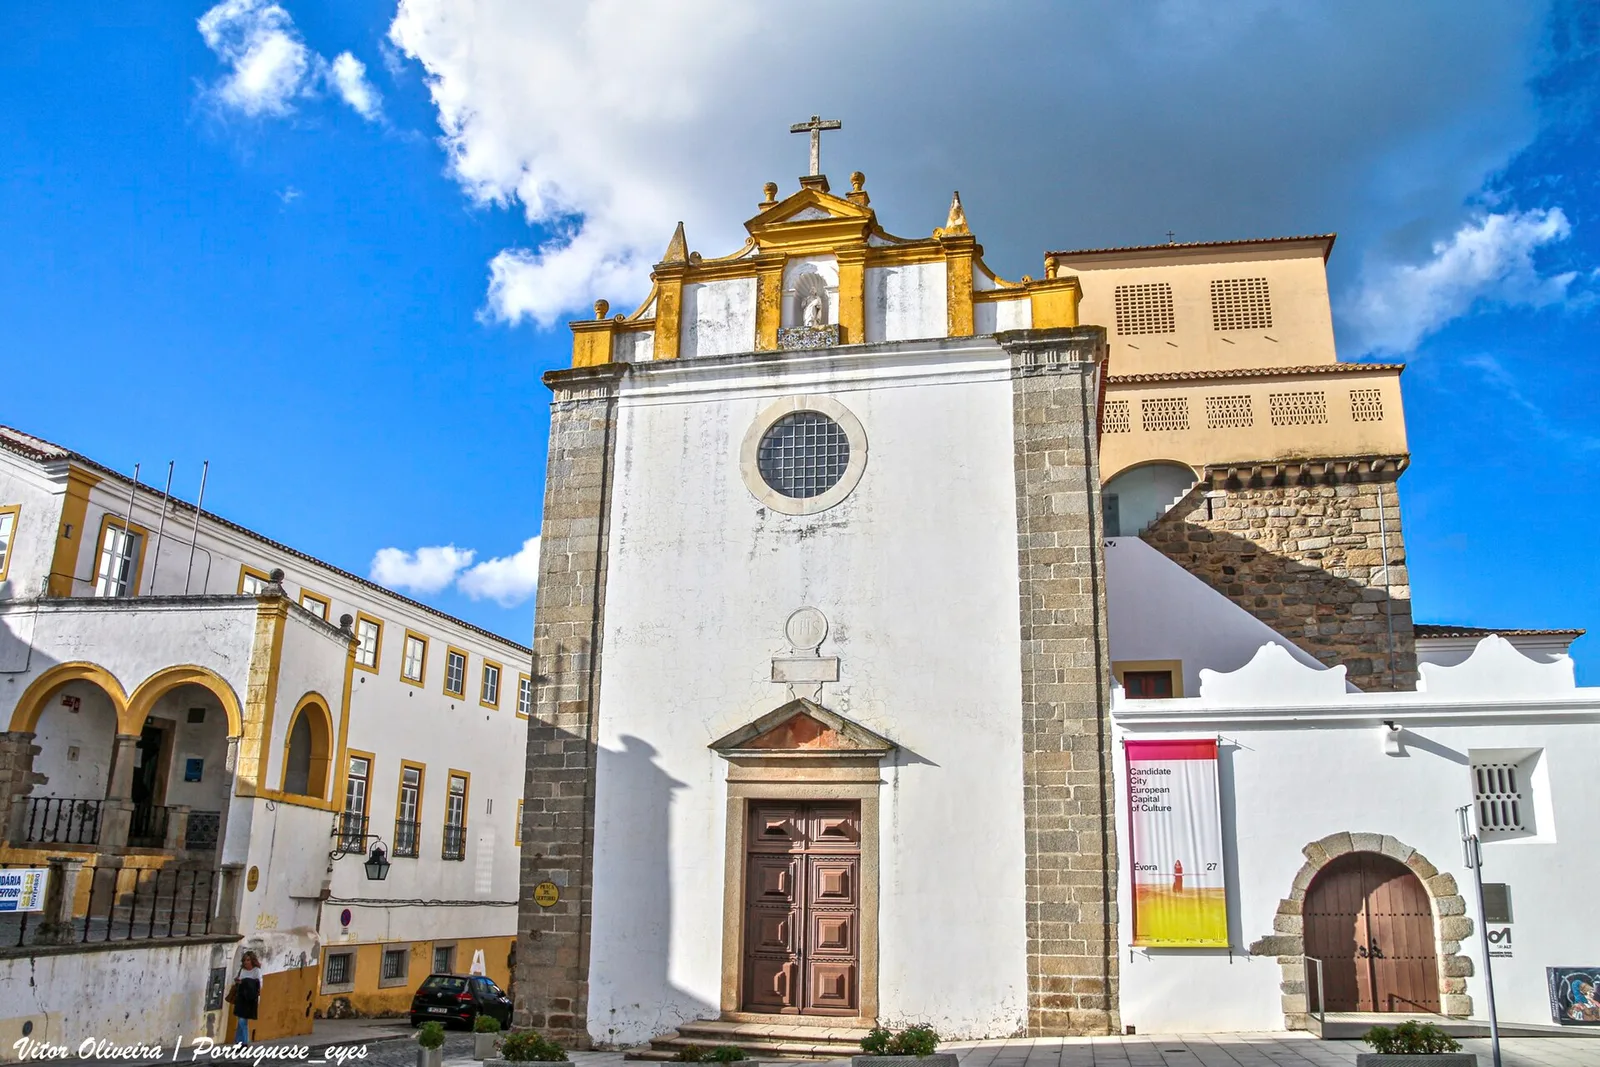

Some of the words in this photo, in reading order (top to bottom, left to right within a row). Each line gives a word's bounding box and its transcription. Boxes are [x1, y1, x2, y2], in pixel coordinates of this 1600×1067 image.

[1130, 767, 1172, 776] Candidate
[1130, 776, 1148, 786] City
[1131, 785, 1170, 795] European
[1131, 795, 1160, 804] Capital
[1131, 804, 1140, 812] of
[1141, 804, 1172, 812] Culture
[1134, 861, 1158, 871] Évora
[1206, 862, 1218, 871] 27
